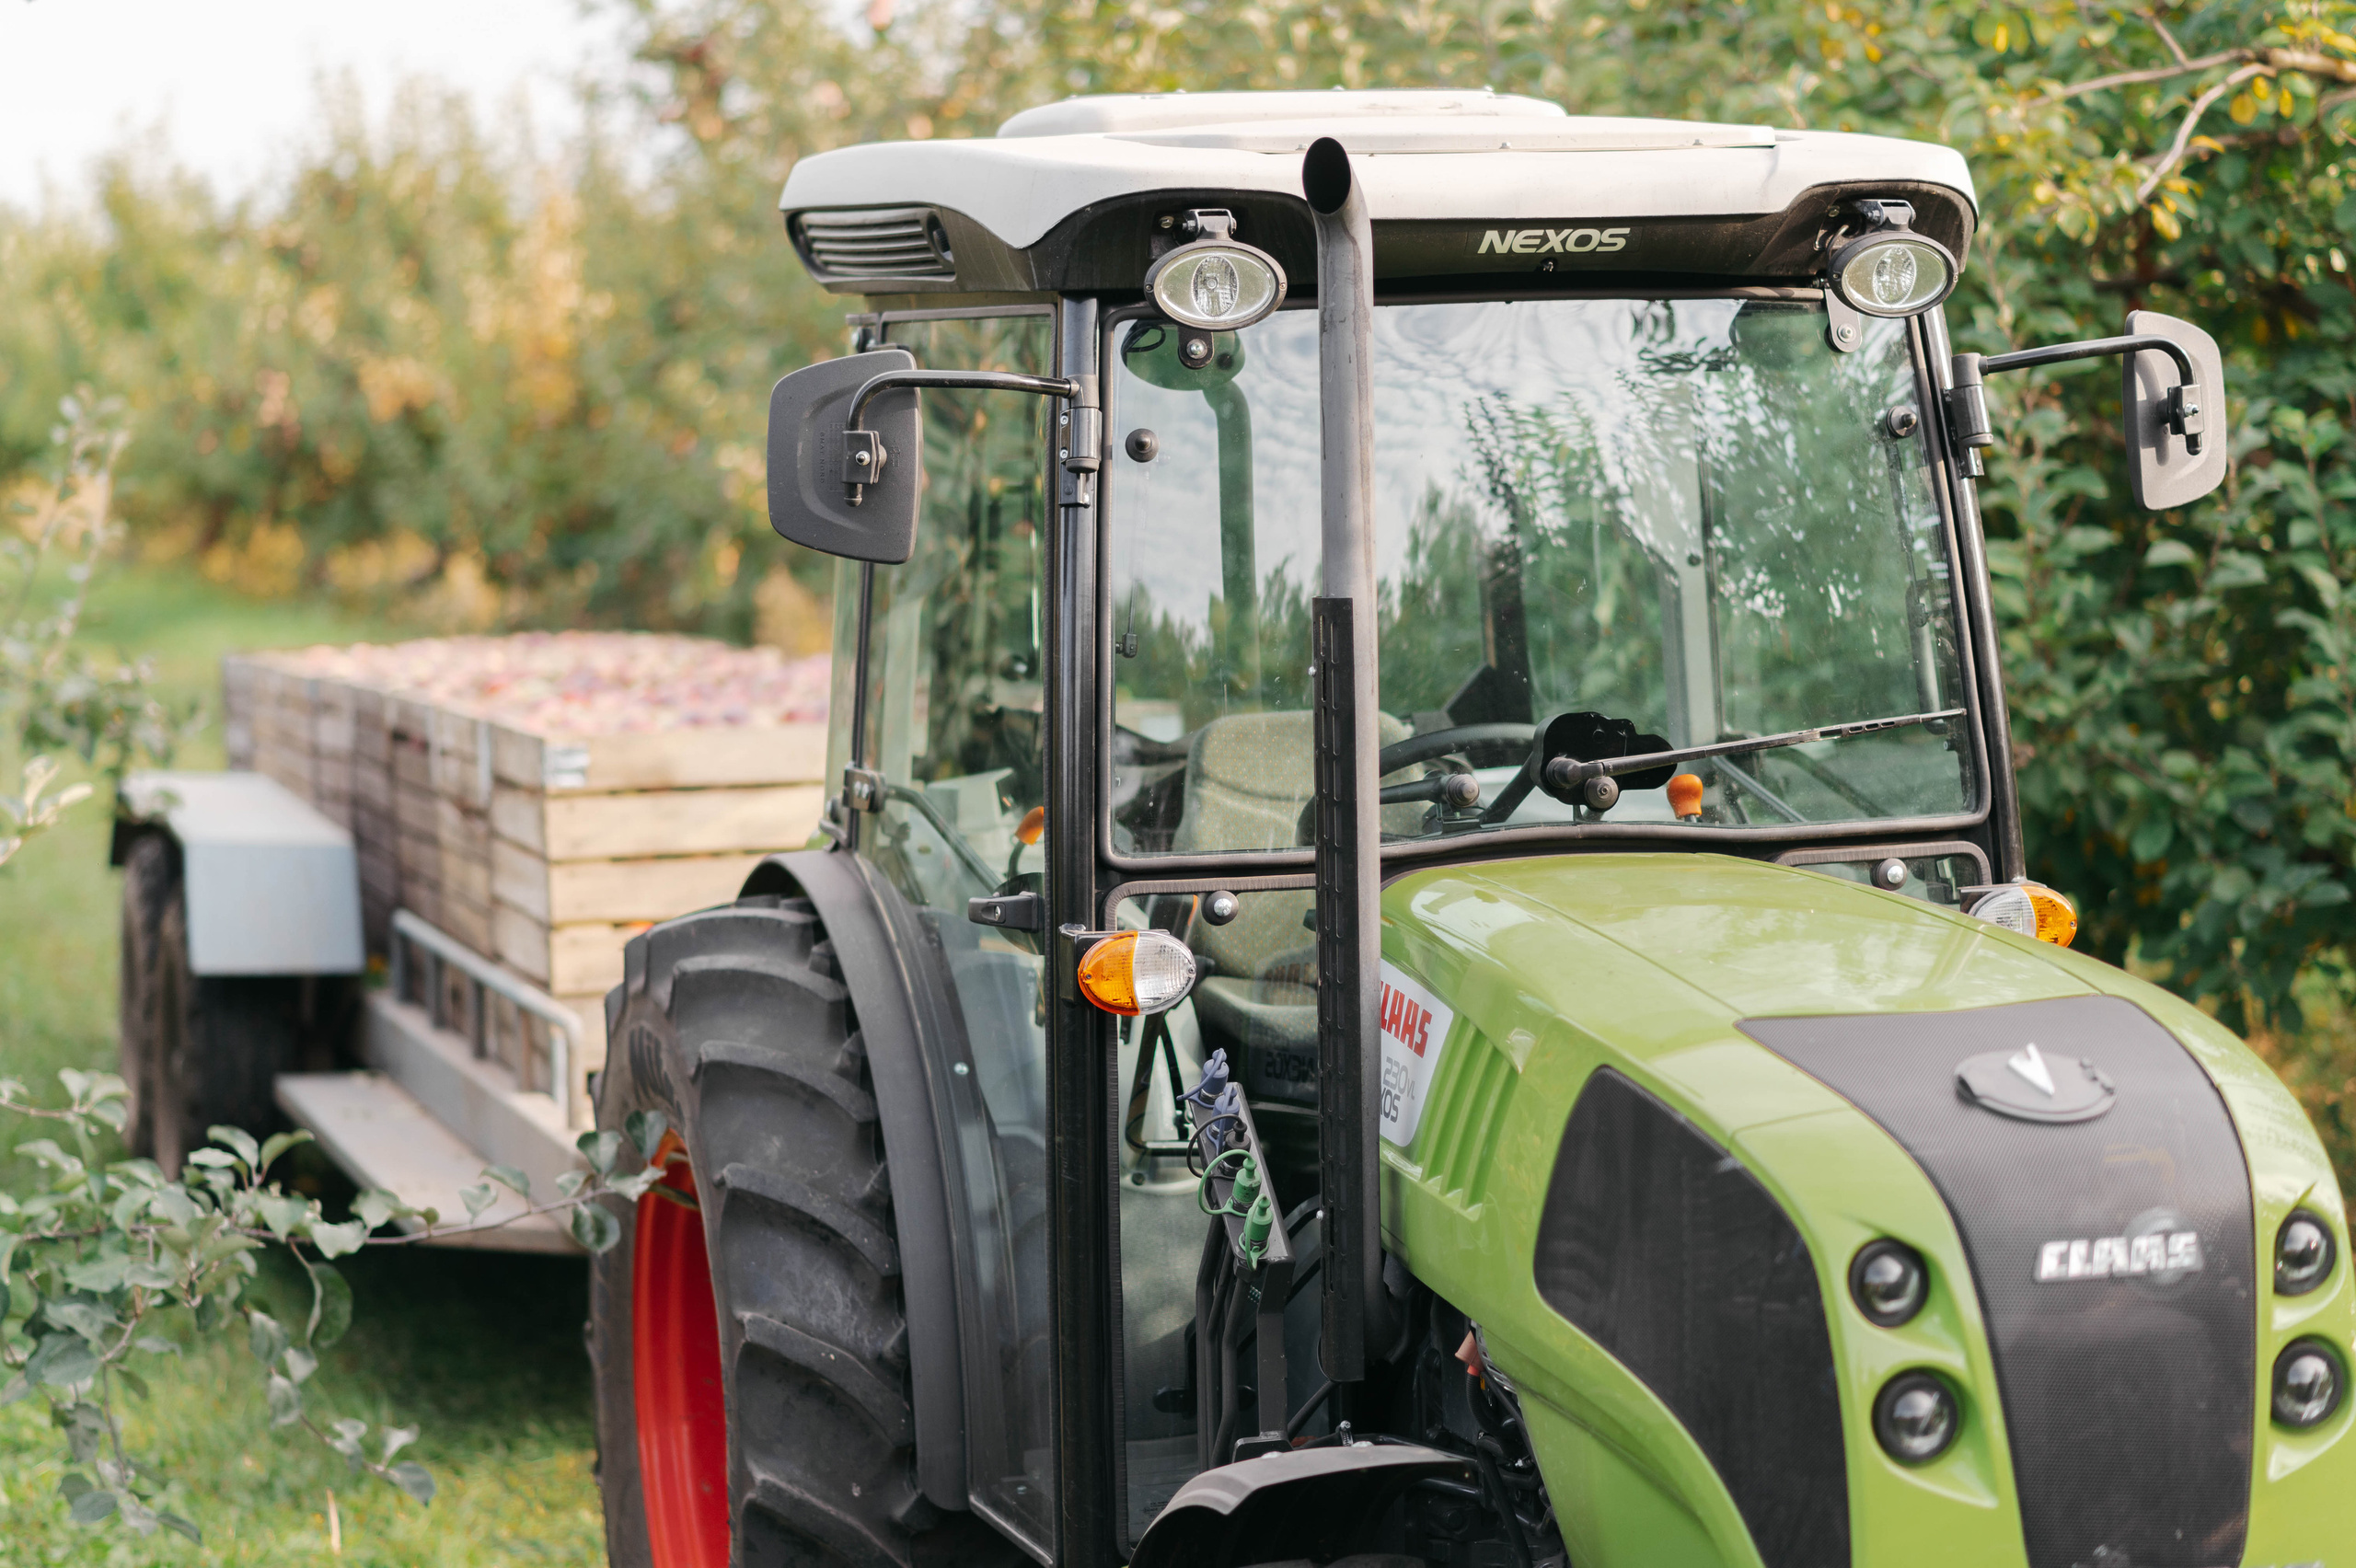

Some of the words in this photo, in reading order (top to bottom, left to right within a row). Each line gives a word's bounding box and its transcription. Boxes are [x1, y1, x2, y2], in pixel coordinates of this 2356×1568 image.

[1477, 227, 1631, 254] NEXOS
[1380, 981, 1432, 1058] LAAS
[2039, 1231, 2200, 1280] CLAAS
